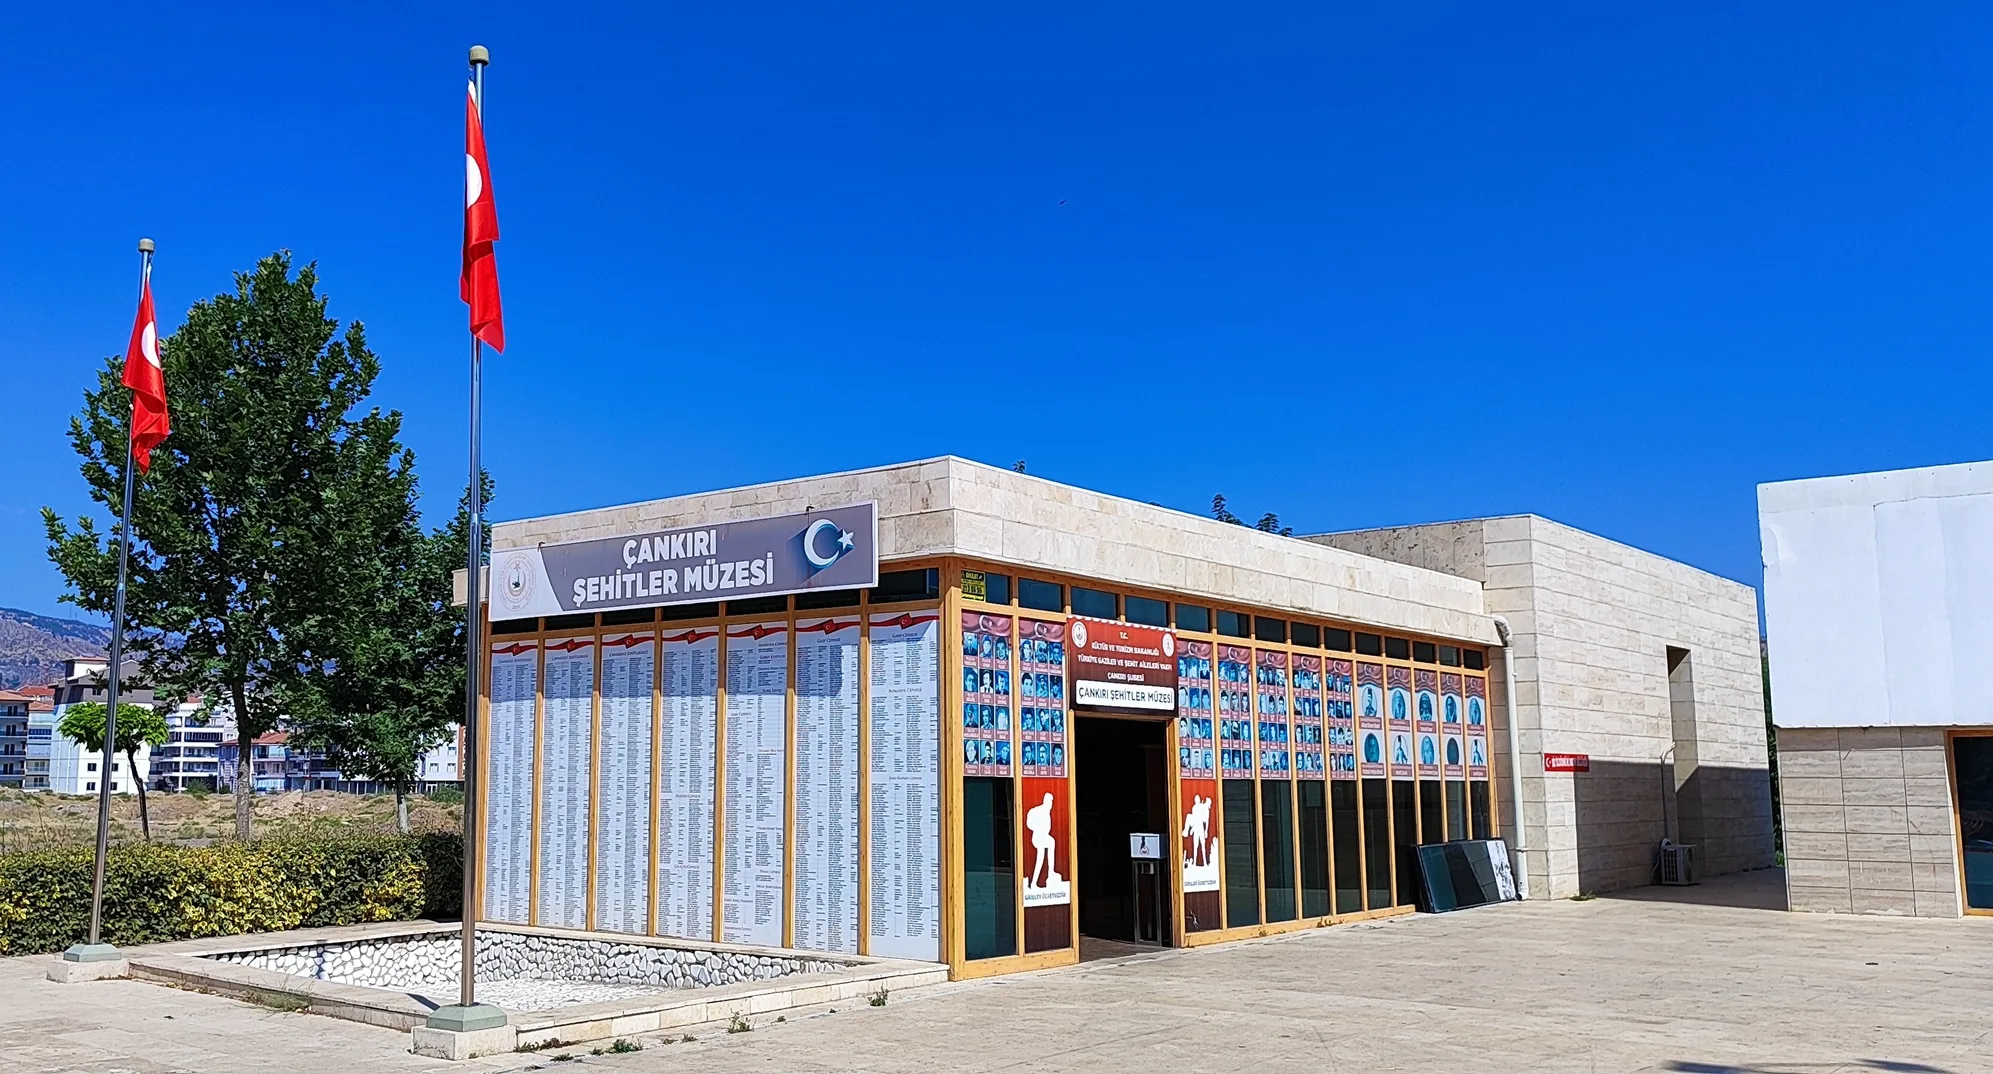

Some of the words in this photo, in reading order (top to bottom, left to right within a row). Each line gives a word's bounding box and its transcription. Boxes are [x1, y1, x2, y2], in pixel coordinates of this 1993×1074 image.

[623, 529, 717, 569] ÇANKIRI
[572, 569, 678, 608] ŞEHİTLER
[684, 552, 774, 593] MÜZESİ
[1078, 654, 1098, 663] TÜRKİYE
[1098, 657, 1116, 666] GAZİLER
[1079, 687, 1108, 699] ÇANKIRI
[1110, 689, 1145, 701] ŞEHİTLER
[1148, 691, 1173, 703] MÜZESİ
